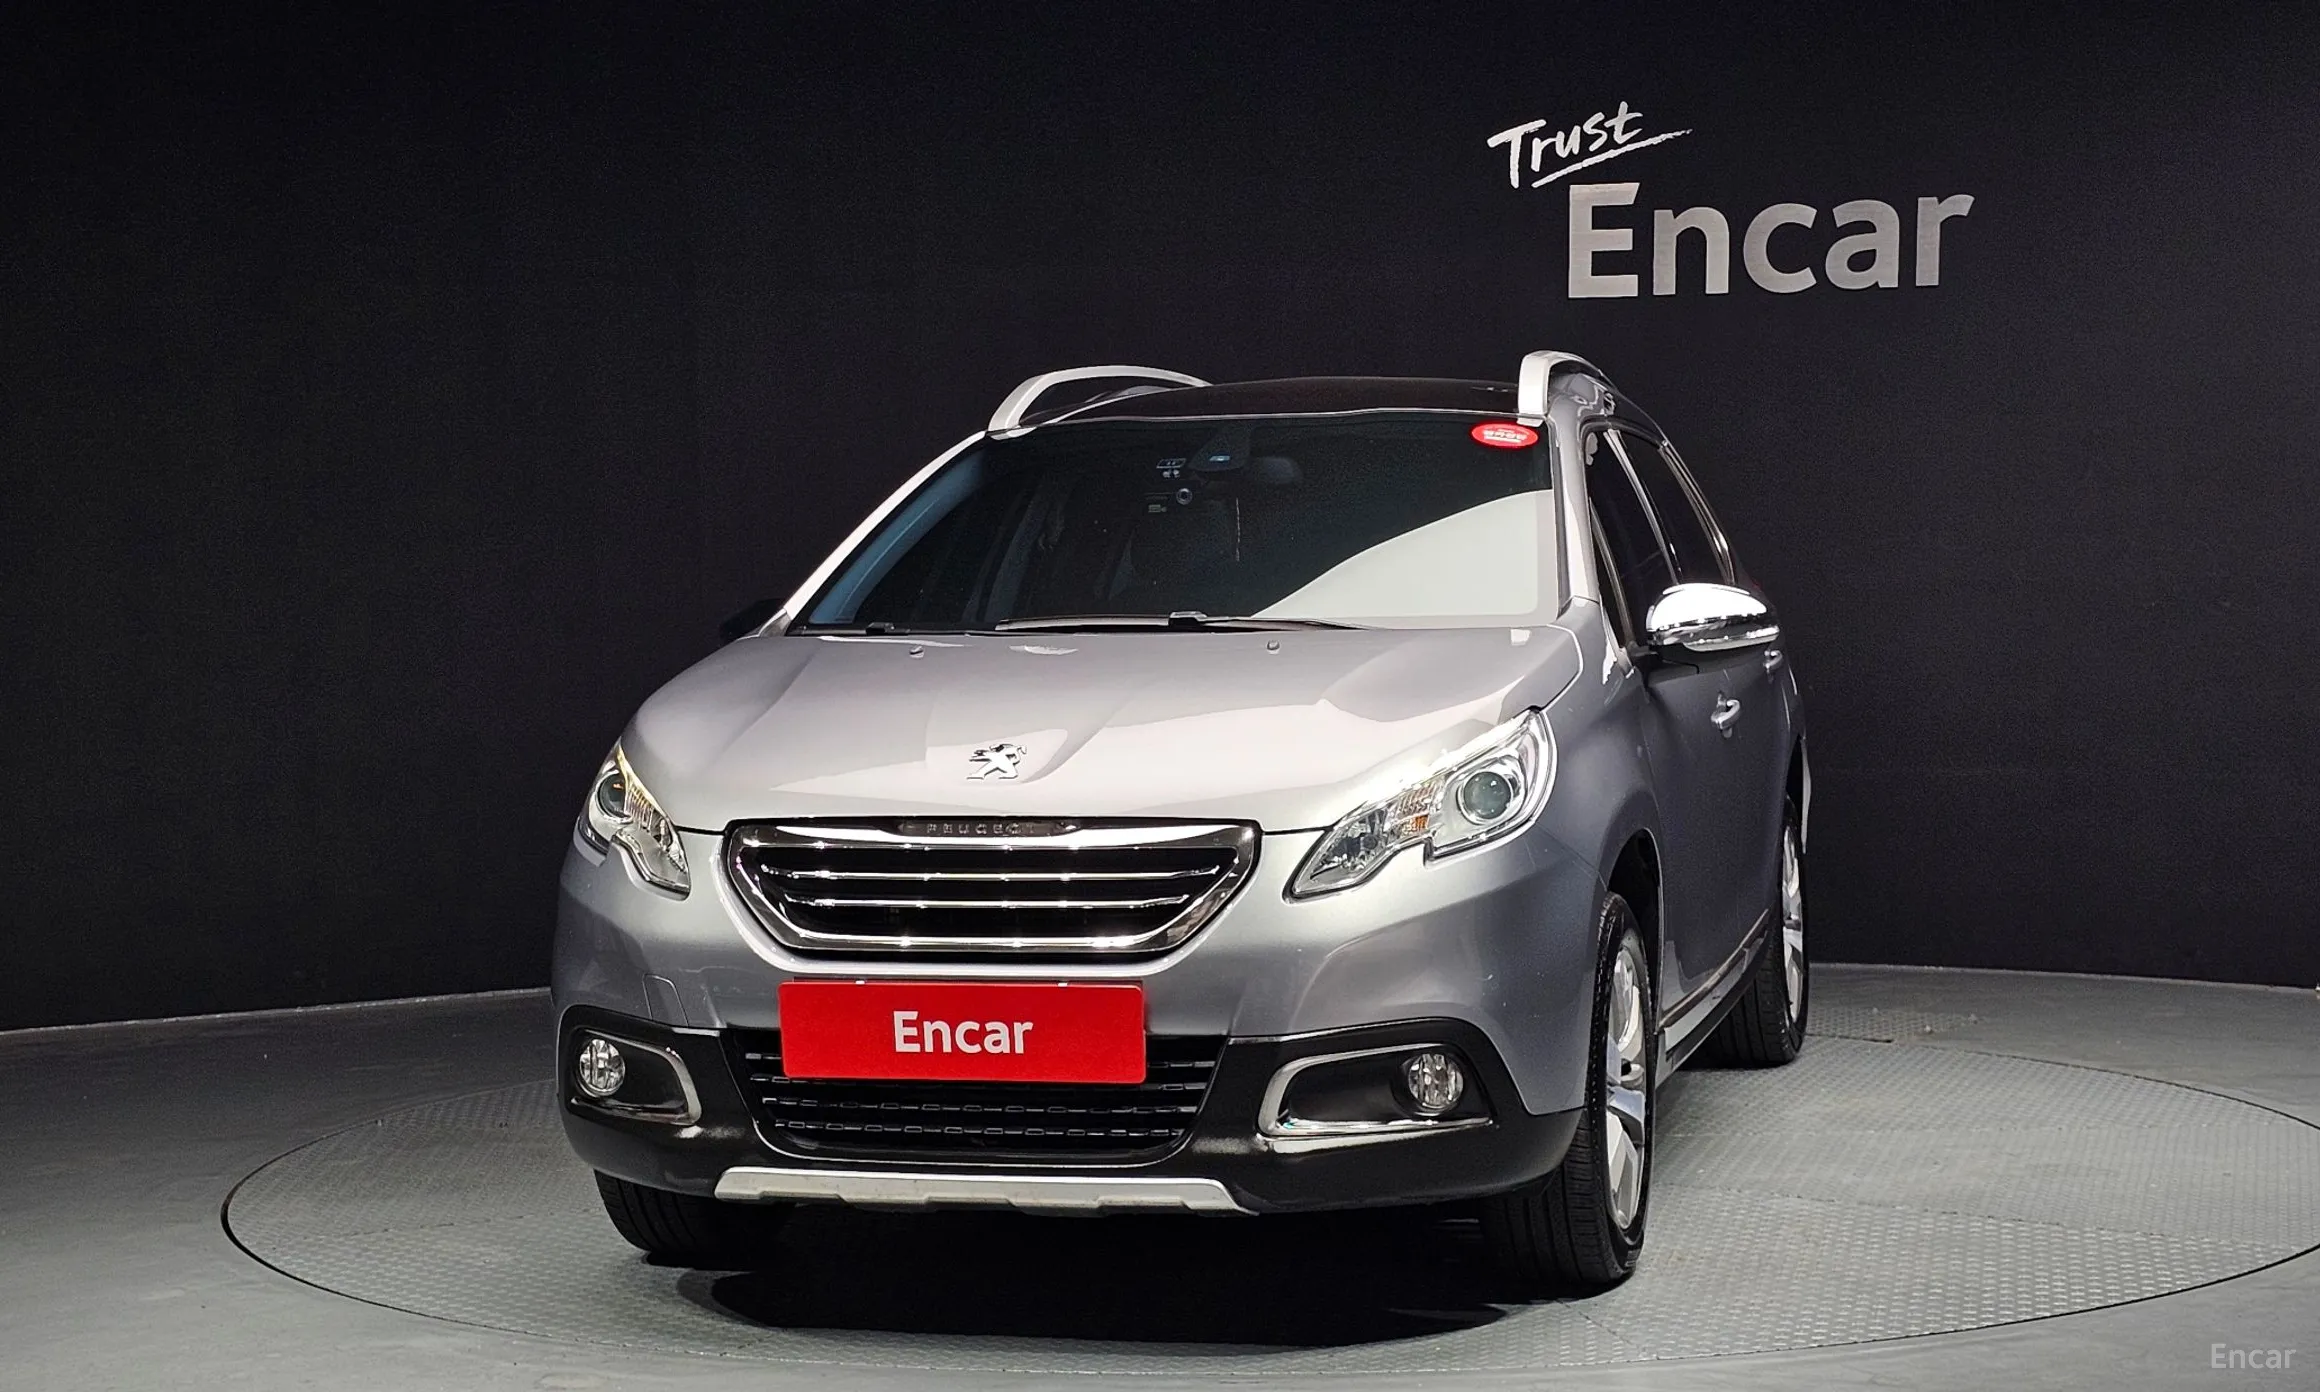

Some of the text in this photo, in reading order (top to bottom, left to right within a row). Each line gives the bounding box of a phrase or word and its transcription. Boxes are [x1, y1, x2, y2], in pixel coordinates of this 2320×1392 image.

[1486, 101, 1643, 188] Trust
[1568, 182, 1975, 299] Encar
[893, 1010, 1033, 1054] Encar
